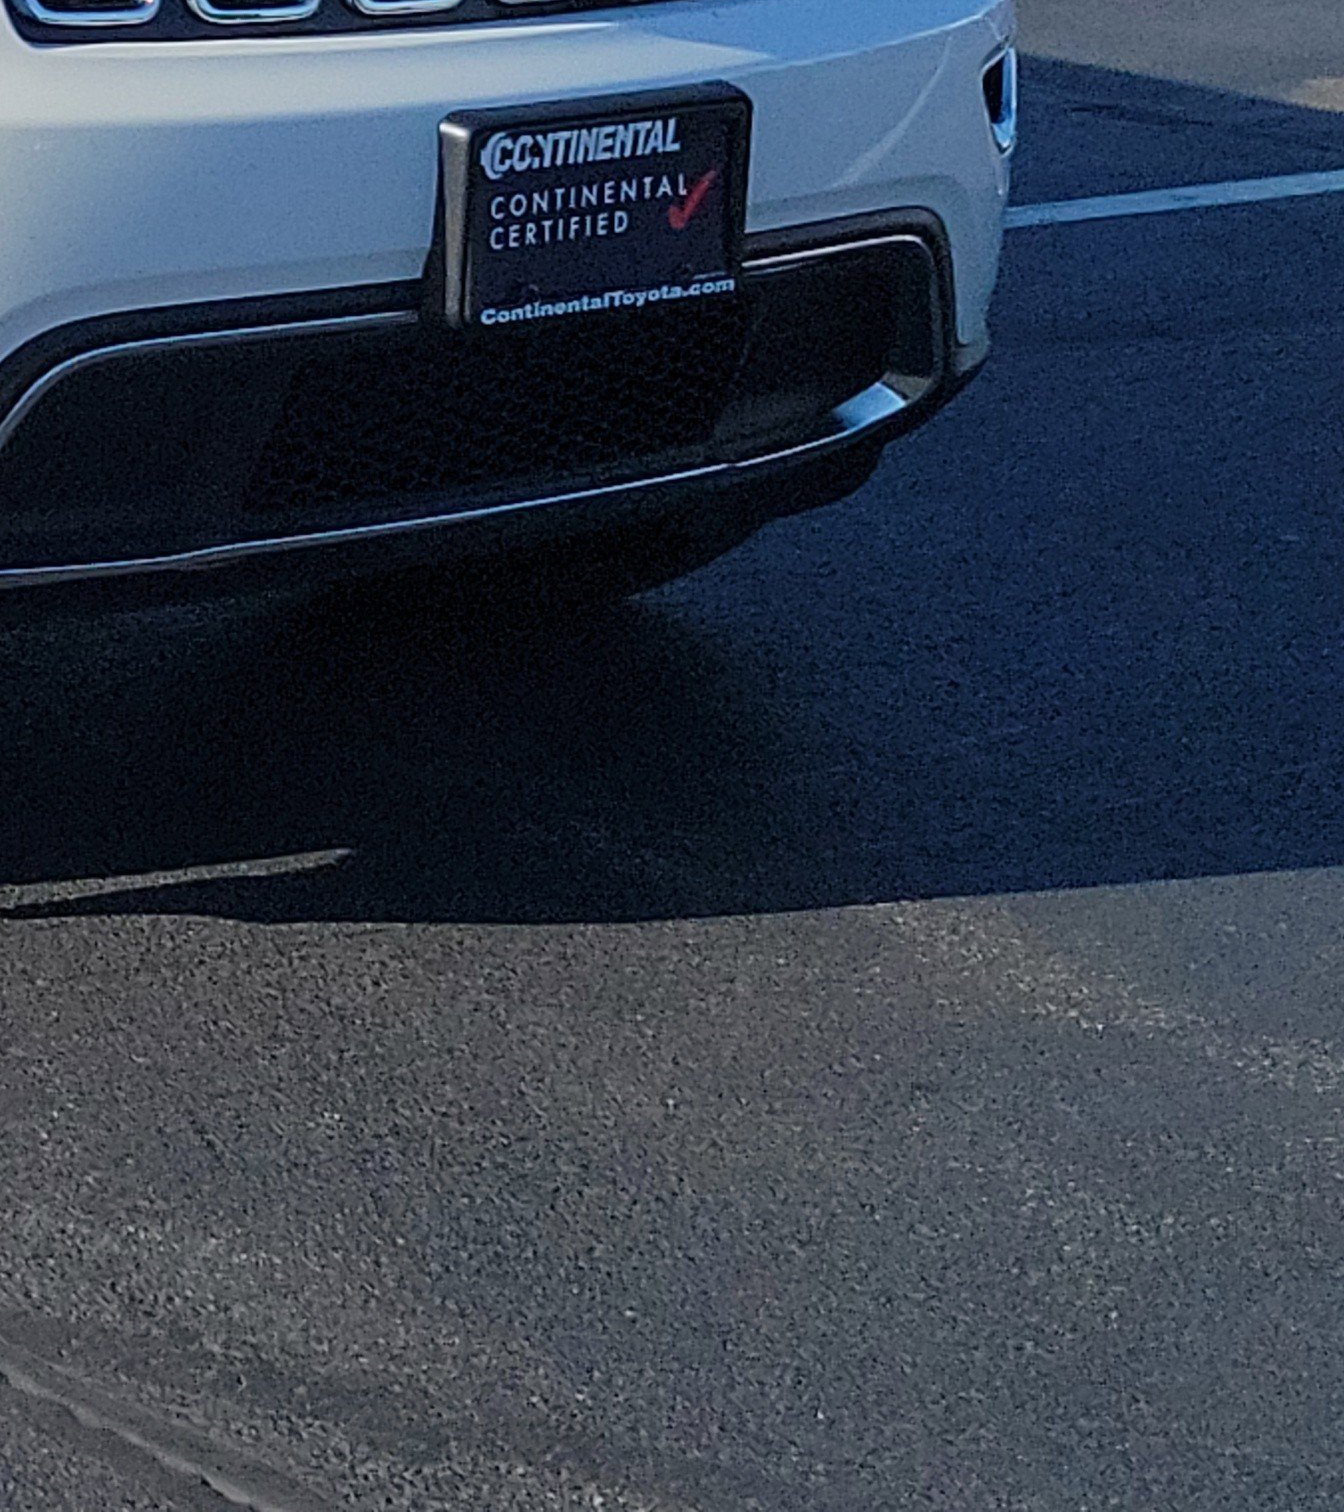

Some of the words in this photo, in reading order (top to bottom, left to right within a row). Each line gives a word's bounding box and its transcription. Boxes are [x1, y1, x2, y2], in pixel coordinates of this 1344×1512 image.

[491, 175, 689, 220] CONTINENTAL
[489, 211, 629, 250] CERTIFIED
[480, 277, 735, 325] ContinentalToyota.com
